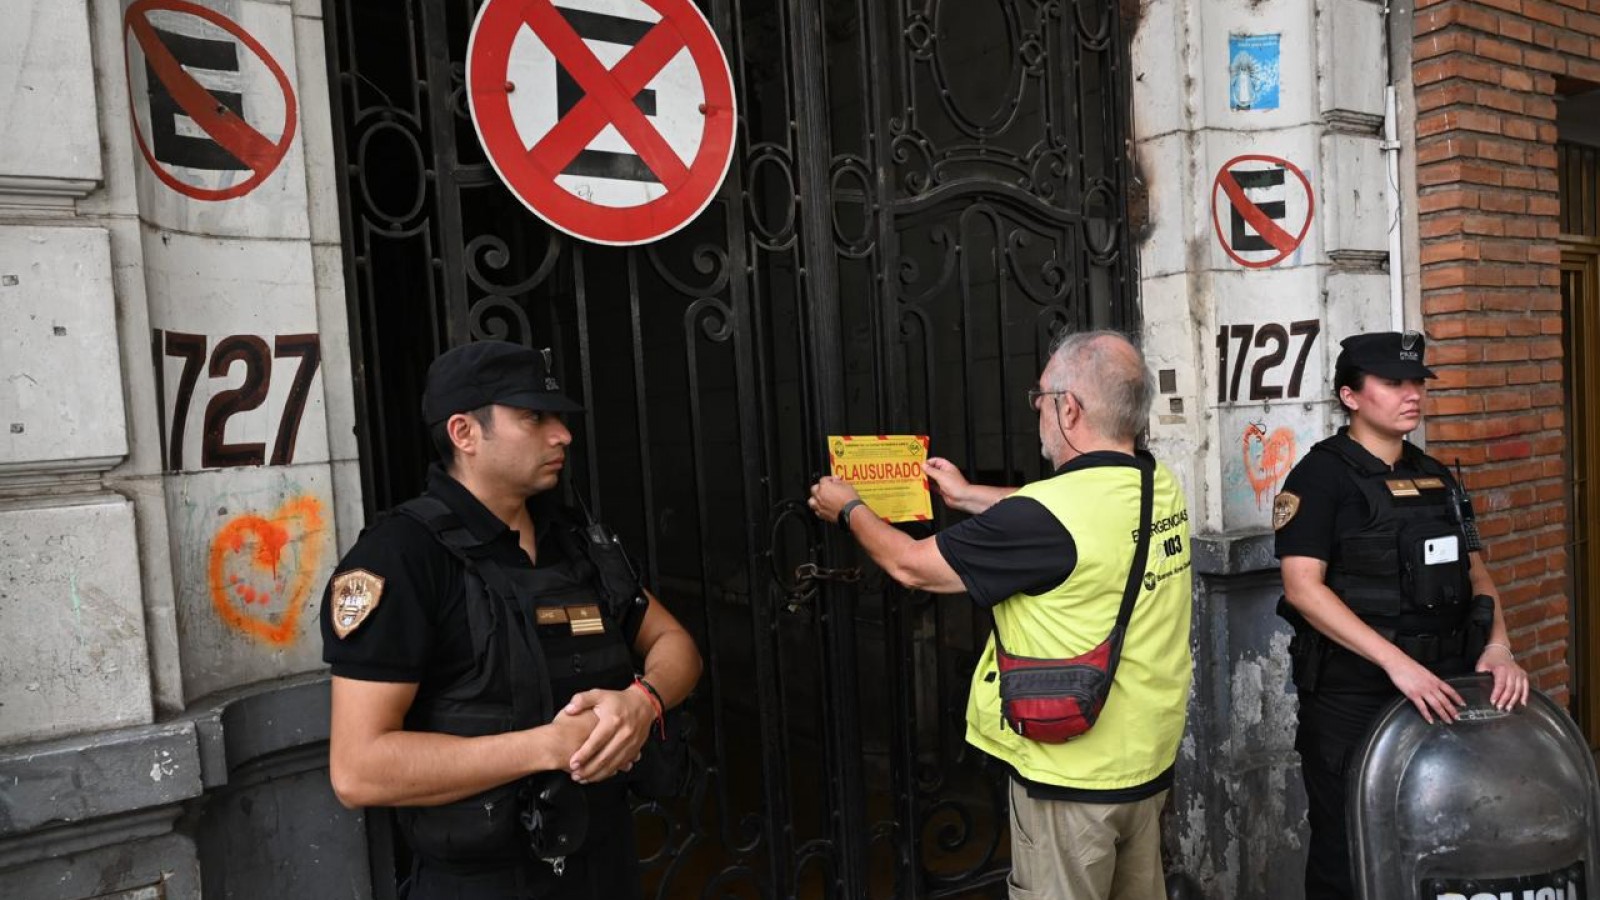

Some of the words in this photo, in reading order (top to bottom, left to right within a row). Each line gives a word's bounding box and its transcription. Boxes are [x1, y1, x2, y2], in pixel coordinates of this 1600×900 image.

[144, 26, 255, 171] E
[554, 5, 662, 183] E
[1229, 168, 1286, 251] E
[152, 328, 321, 472] 1727
[1216, 319, 1320, 403] 1727
[835, 461, 921, 481] CLAUSURADO
[1131, 509, 1188, 543] ERGENCIAS
[1164, 534, 1182, 557] 103
